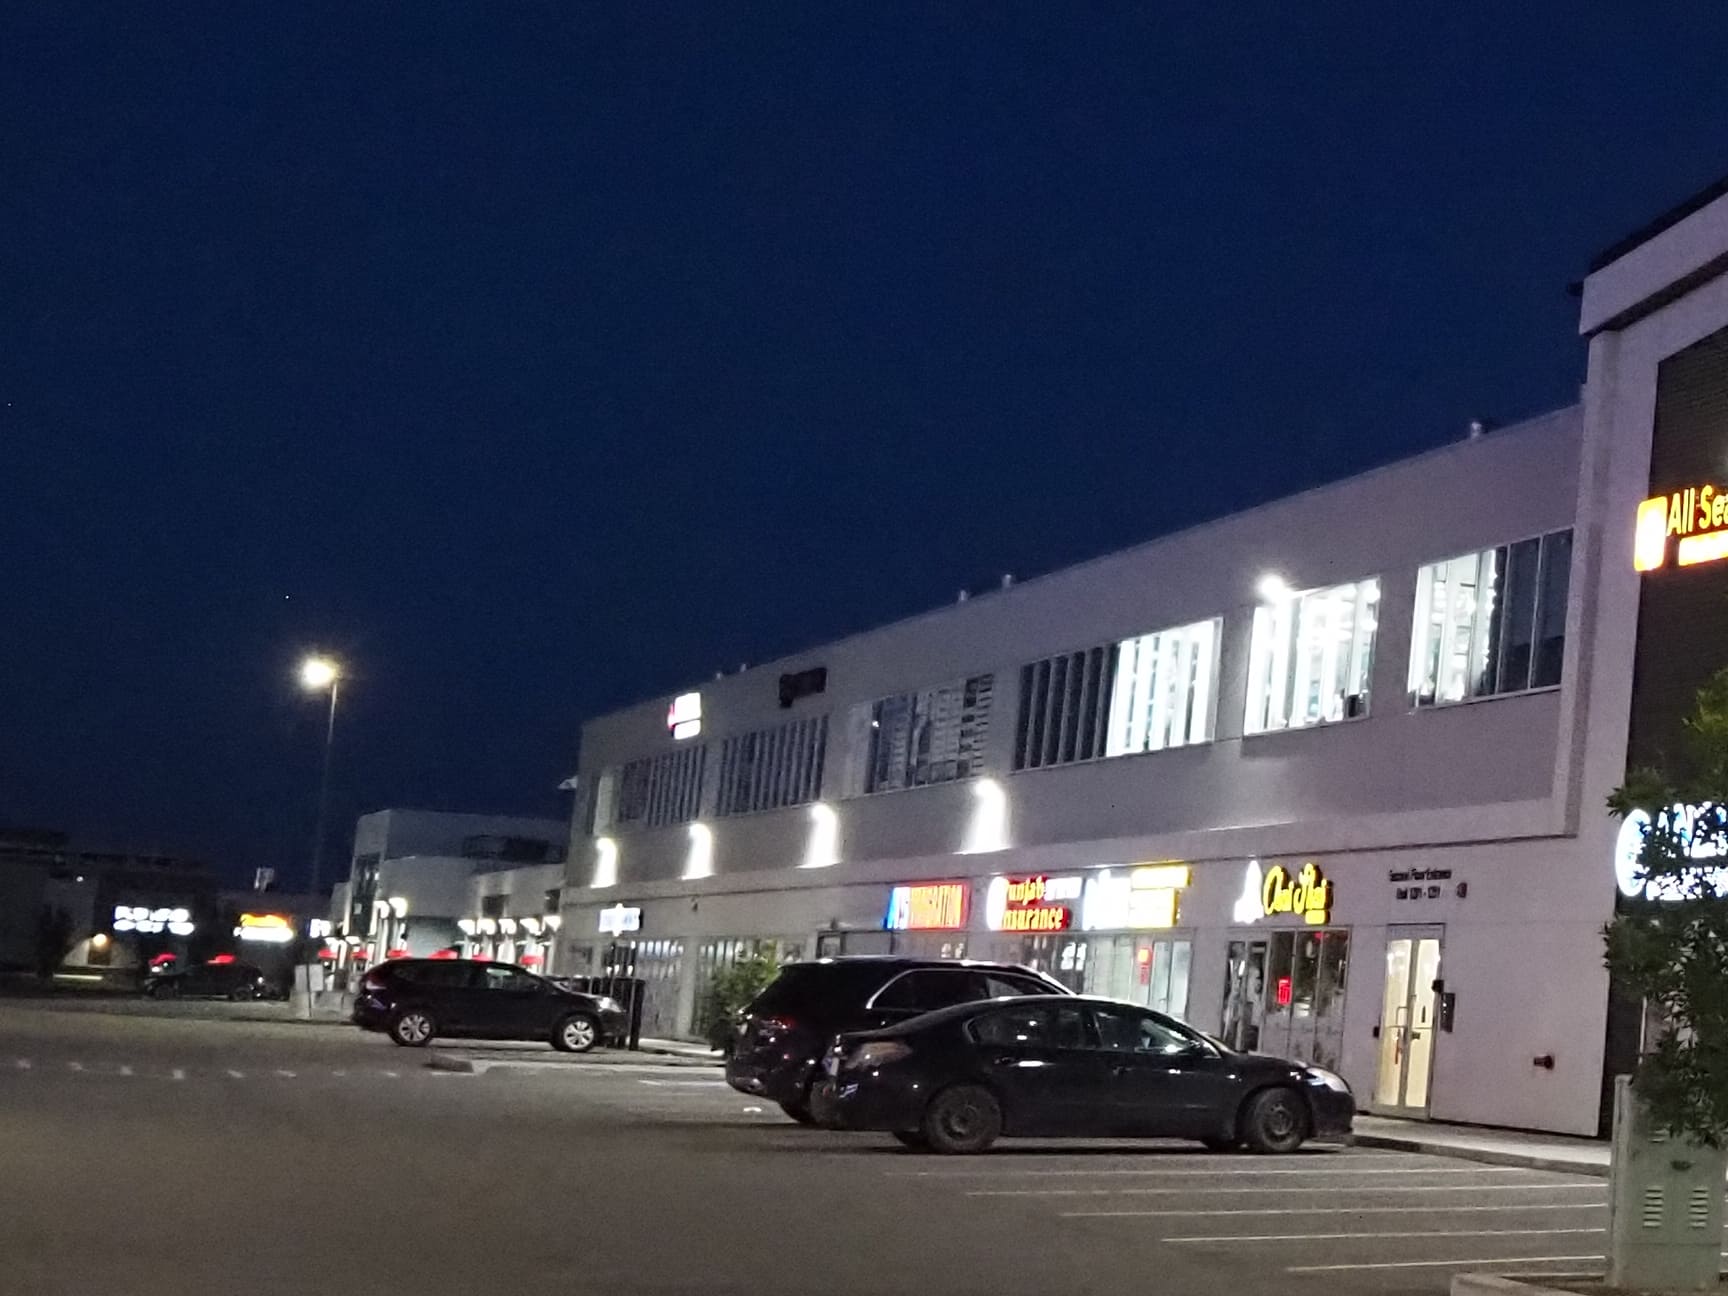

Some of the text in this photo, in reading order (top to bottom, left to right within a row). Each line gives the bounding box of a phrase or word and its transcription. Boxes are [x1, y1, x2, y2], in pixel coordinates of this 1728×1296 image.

[1665, 487, 1696, 537] All
[1006, 875, 1046, 906] unjab
[1000, 906, 1065, 931] nsurance
